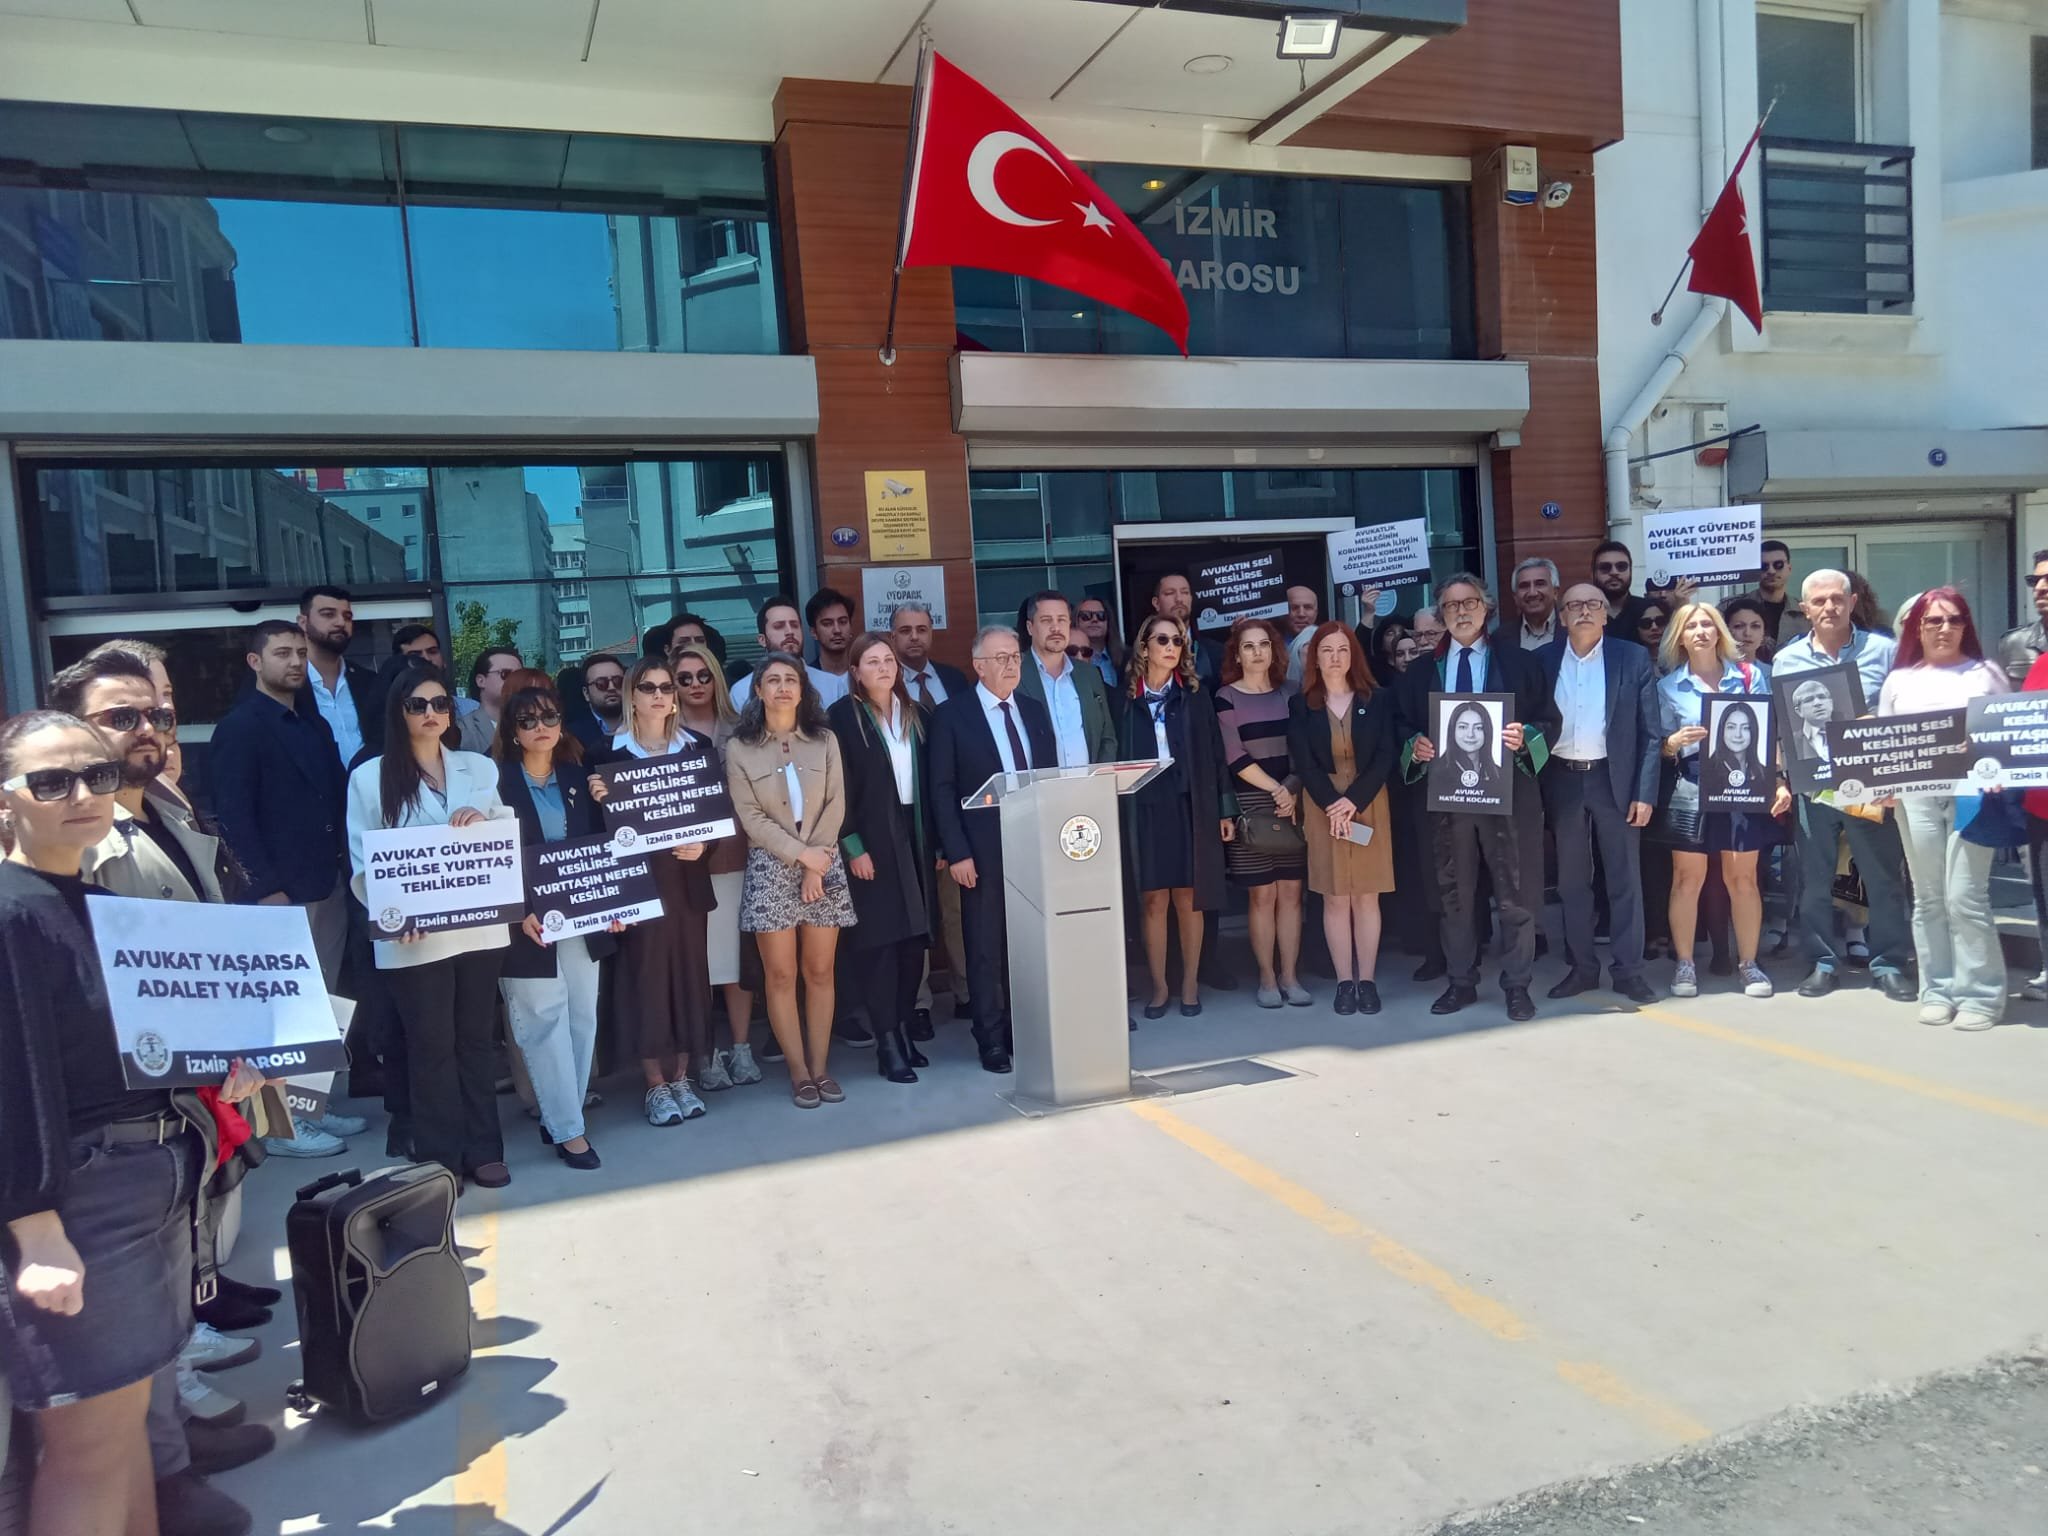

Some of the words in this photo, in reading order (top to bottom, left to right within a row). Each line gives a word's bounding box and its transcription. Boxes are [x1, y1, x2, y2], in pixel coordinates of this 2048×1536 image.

[1174, 198, 1278, 238] İZMİR
[1354, 532, 1399, 545] MESLEĞİNİN
[1355, 525, 1396, 537] AVUKATLIK
[1648, 525, 1695, 539] AVUKAT
[1698, 520, 1756, 534] GÜVENDE
[1337, 541, 1391, 556] KORUNMASINA
[1392, 536, 1419, 546] İLİŞKİN
[1649, 536, 1698, 550] DEĞİLSE
[1700, 533, 1755, 548] YURTTAŞ
[1343, 557, 1387, 571] SÖZLEŞMESİ
[1387, 553, 1418, 563] DERHAL
[1348, 552, 1377, 562] AVRUPA
[1378, 545, 1411, 557] KONSEYİ
[1667, 546, 1736, 560] TEHLİKEDE!
[1201, 561, 1250, 577] AVUKATIN
[1252, 554, 1273, 567] SESİ
[1358, 563, 1403, 576] İMZALANSIN
[1195, 583, 1250, 599] YURTTAŞIN
[1251, 574, 1283, 589] NEFESİ
[1214, 570, 1263, 585] KESİLİRSE
[1385, 576, 1418, 587] BAROSU
[1703, 573, 1740, 582] BAROSU
[886, 590, 922, 600] OTOPARK
[1222, 591, 1262, 605] KESİLİR!
[1983, 699, 2048, 714] AVUKAT
[1842, 725, 1917, 740] AVUKATIN
[1921, 717, 1953, 731] SESİ
[2003, 711, 2048, 727] KESİL
[1862, 734, 1936, 751] KESİLİRSE
[1833, 750, 1914, 767] YURTTAŞIN
[1918, 744, 1964, 758] NEFES
[613, 764, 680, 783] AVUKATIN
[682, 756, 708, 771] SESİ
[1872, 760, 1933, 776] KESİLİR!
[632, 775, 696, 794] KESİLİRSE
[1873, 786, 1903, 797] İZMİR
[1905, 783, 1951, 794] BAROSU
[606, 792, 680, 814] YURTTAŞIN
[682, 781, 723, 801] NEFESİ
[643, 804, 696, 822] KESİLİR!
[645, 833, 673, 846] İZMİR
[675, 826, 714, 840] BAROSU
[371, 847, 436, 864] AVUKAT
[440, 839, 514, 856] GÜVENDE
[538, 844, 601, 865] AVUKATIN
[374, 862, 440, 880] DEĞİLSE
[444, 855, 514, 873] YURTTAŞ
[557, 857, 619, 877] KESİLİRSE
[401, 874, 491, 894] TEHLİKEDE!
[533, 875, 602, 896] YURTTAŞIN
[605, 862, 648, 882] NEFESİ
[569, 885, 620, 905] KESİLİR!
[415, 914, 448, 929] İZMİR
[451, 909, 499, 924] BAROSU
[573, 917, 599, 930] İZMİR
[601, 908, 640, 923] BAROSU
[113, 949, 202, 970] AVUKAT
[207, 953, 310, 976] YAŞARSA
[137, 979, 220, 998] ADALET
[225, 980, 300, 1003] YAŞAR
[185, 1054, 228, 1074] İZMİR
[232, 1050, 306, 1070] AROSU
[287, 1095, 317, 1112] OSU
